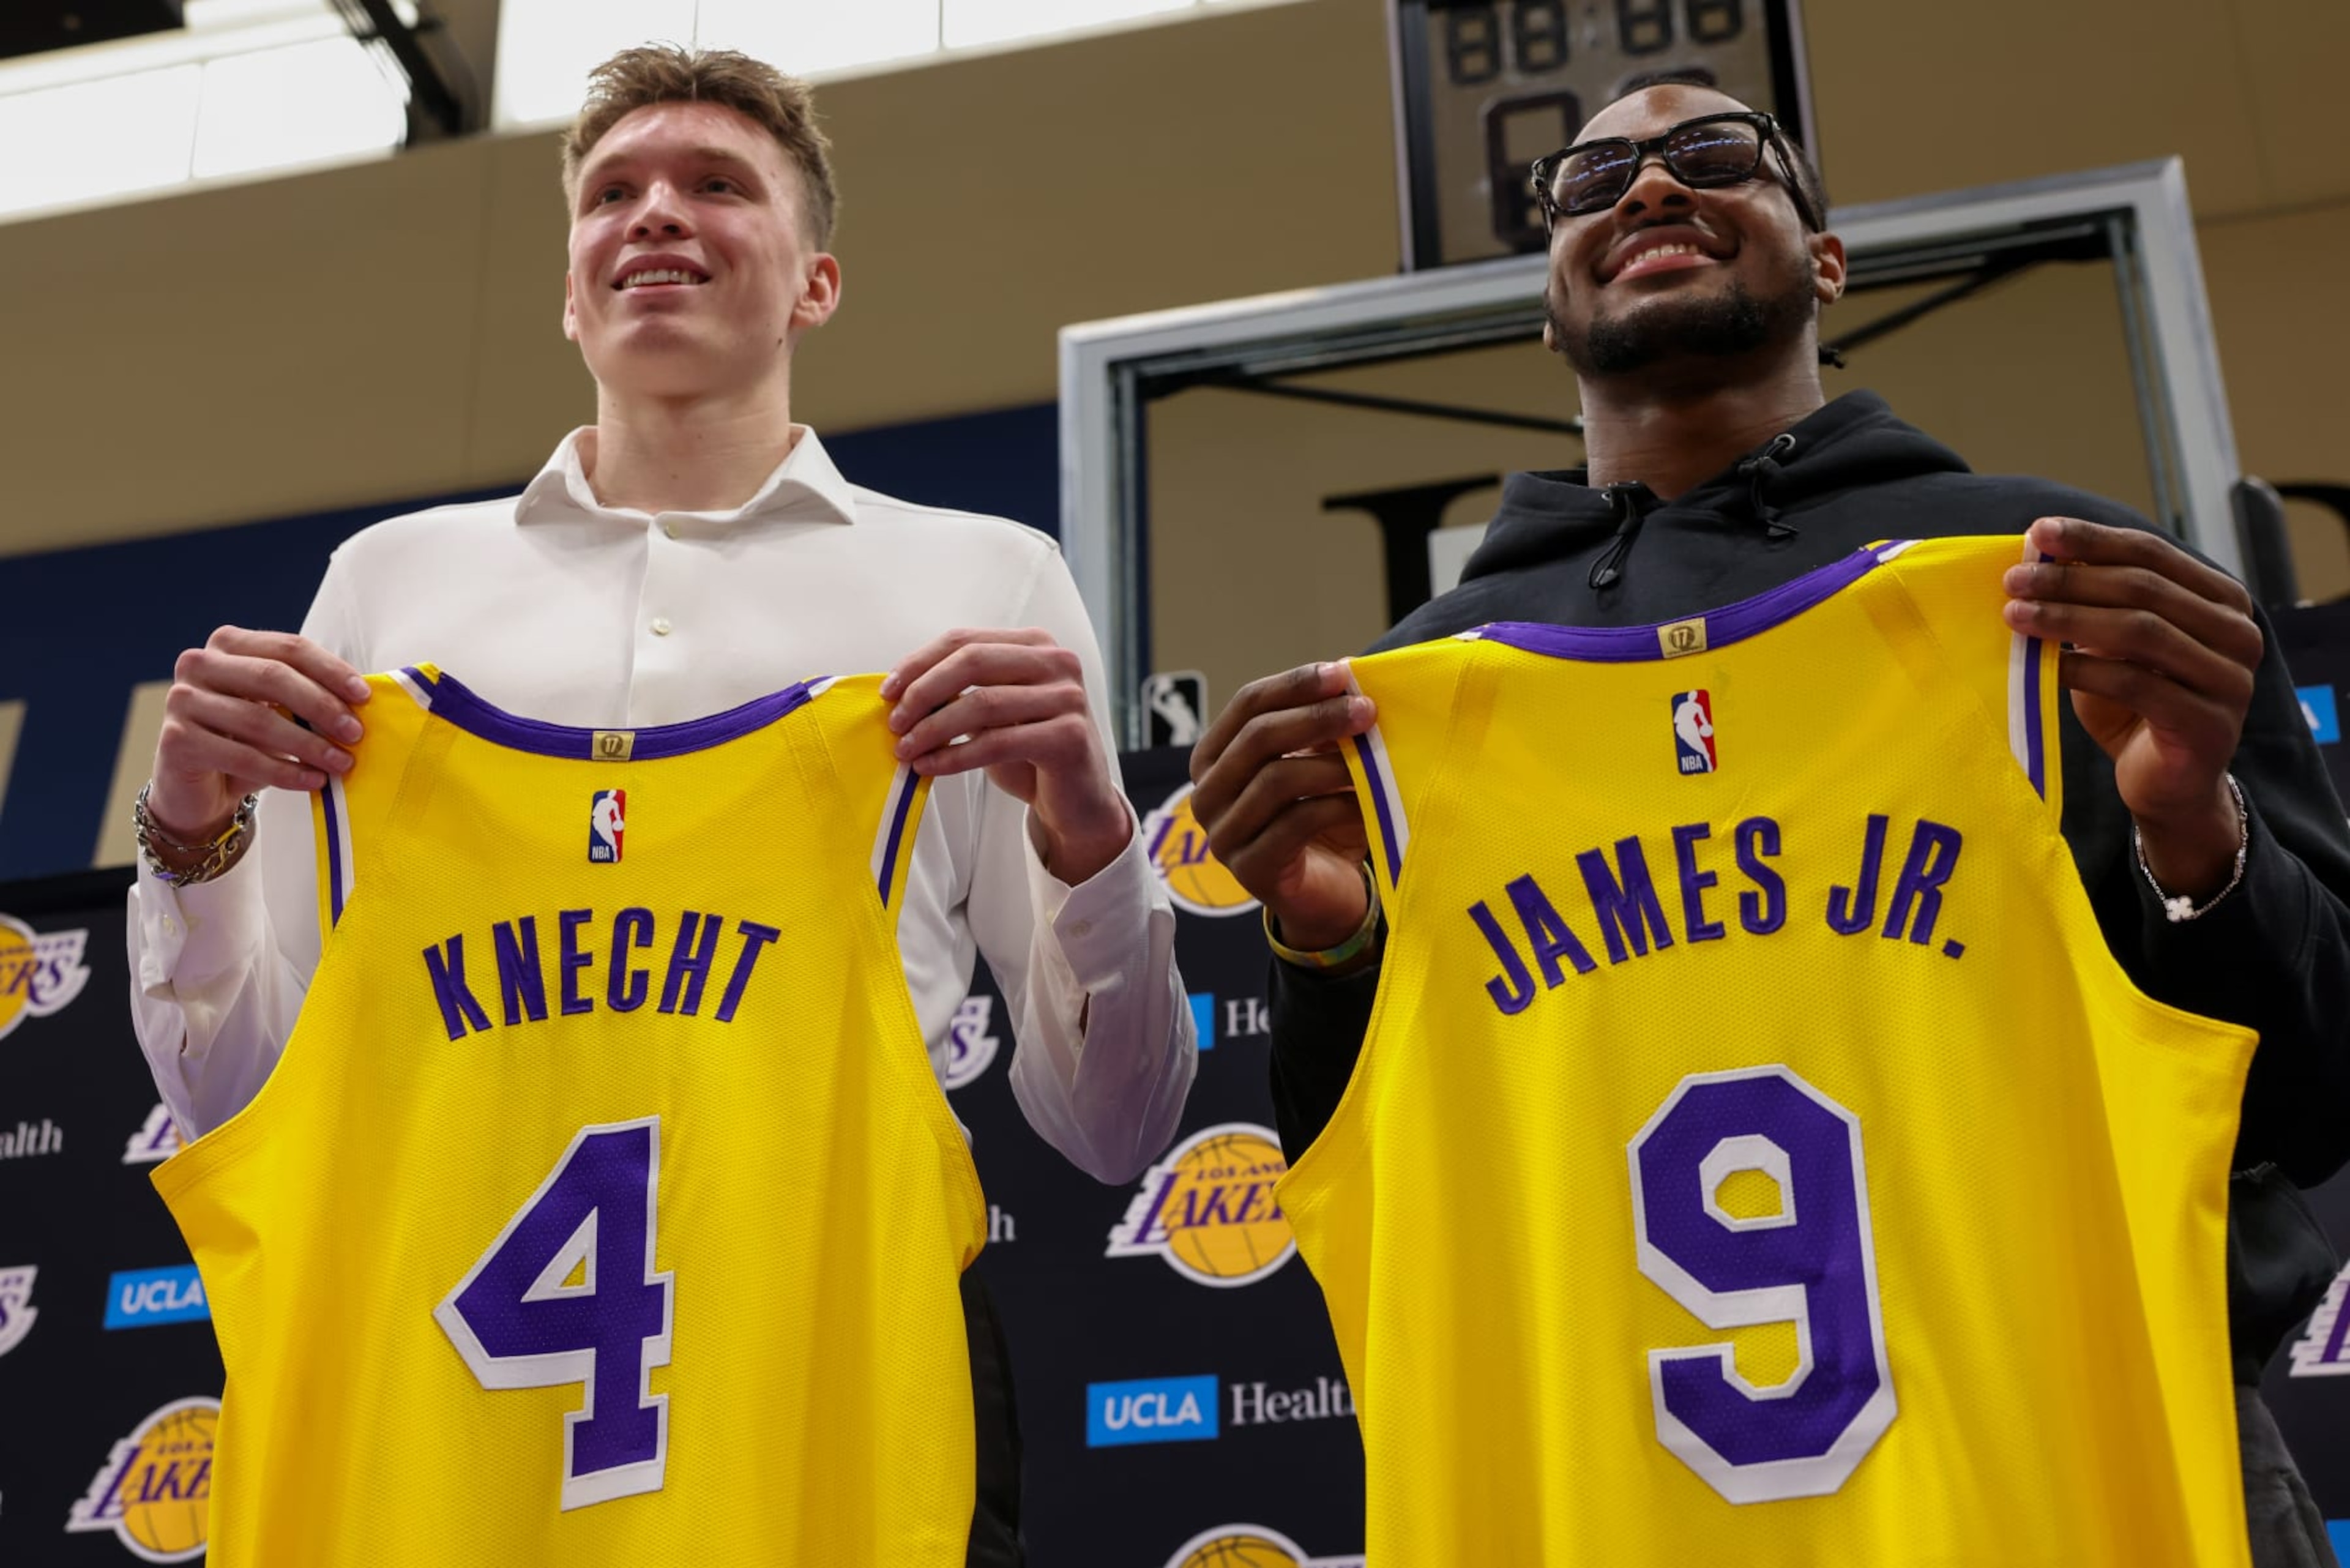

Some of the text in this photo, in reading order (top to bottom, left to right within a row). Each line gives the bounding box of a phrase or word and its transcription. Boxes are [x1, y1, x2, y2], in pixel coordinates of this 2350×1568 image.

[605, 737, 619, 753] 17
[1681, 755, 1704, 772] NBA
[592, 845, 611, 860] NBA
[1468, 814, 1966, 1016] JAMES JR.
[423, 906, 781, 1041] KNECHT
[1196, 1165, 1236, 1181] LOS
[122, 1279, 203, 1314] UCLA
[1626, 1063, 1898, 1506] 9
[432, 1114, 674, 1512] 4
[1105, 1376, 1357, 1430] UCLA Healt
